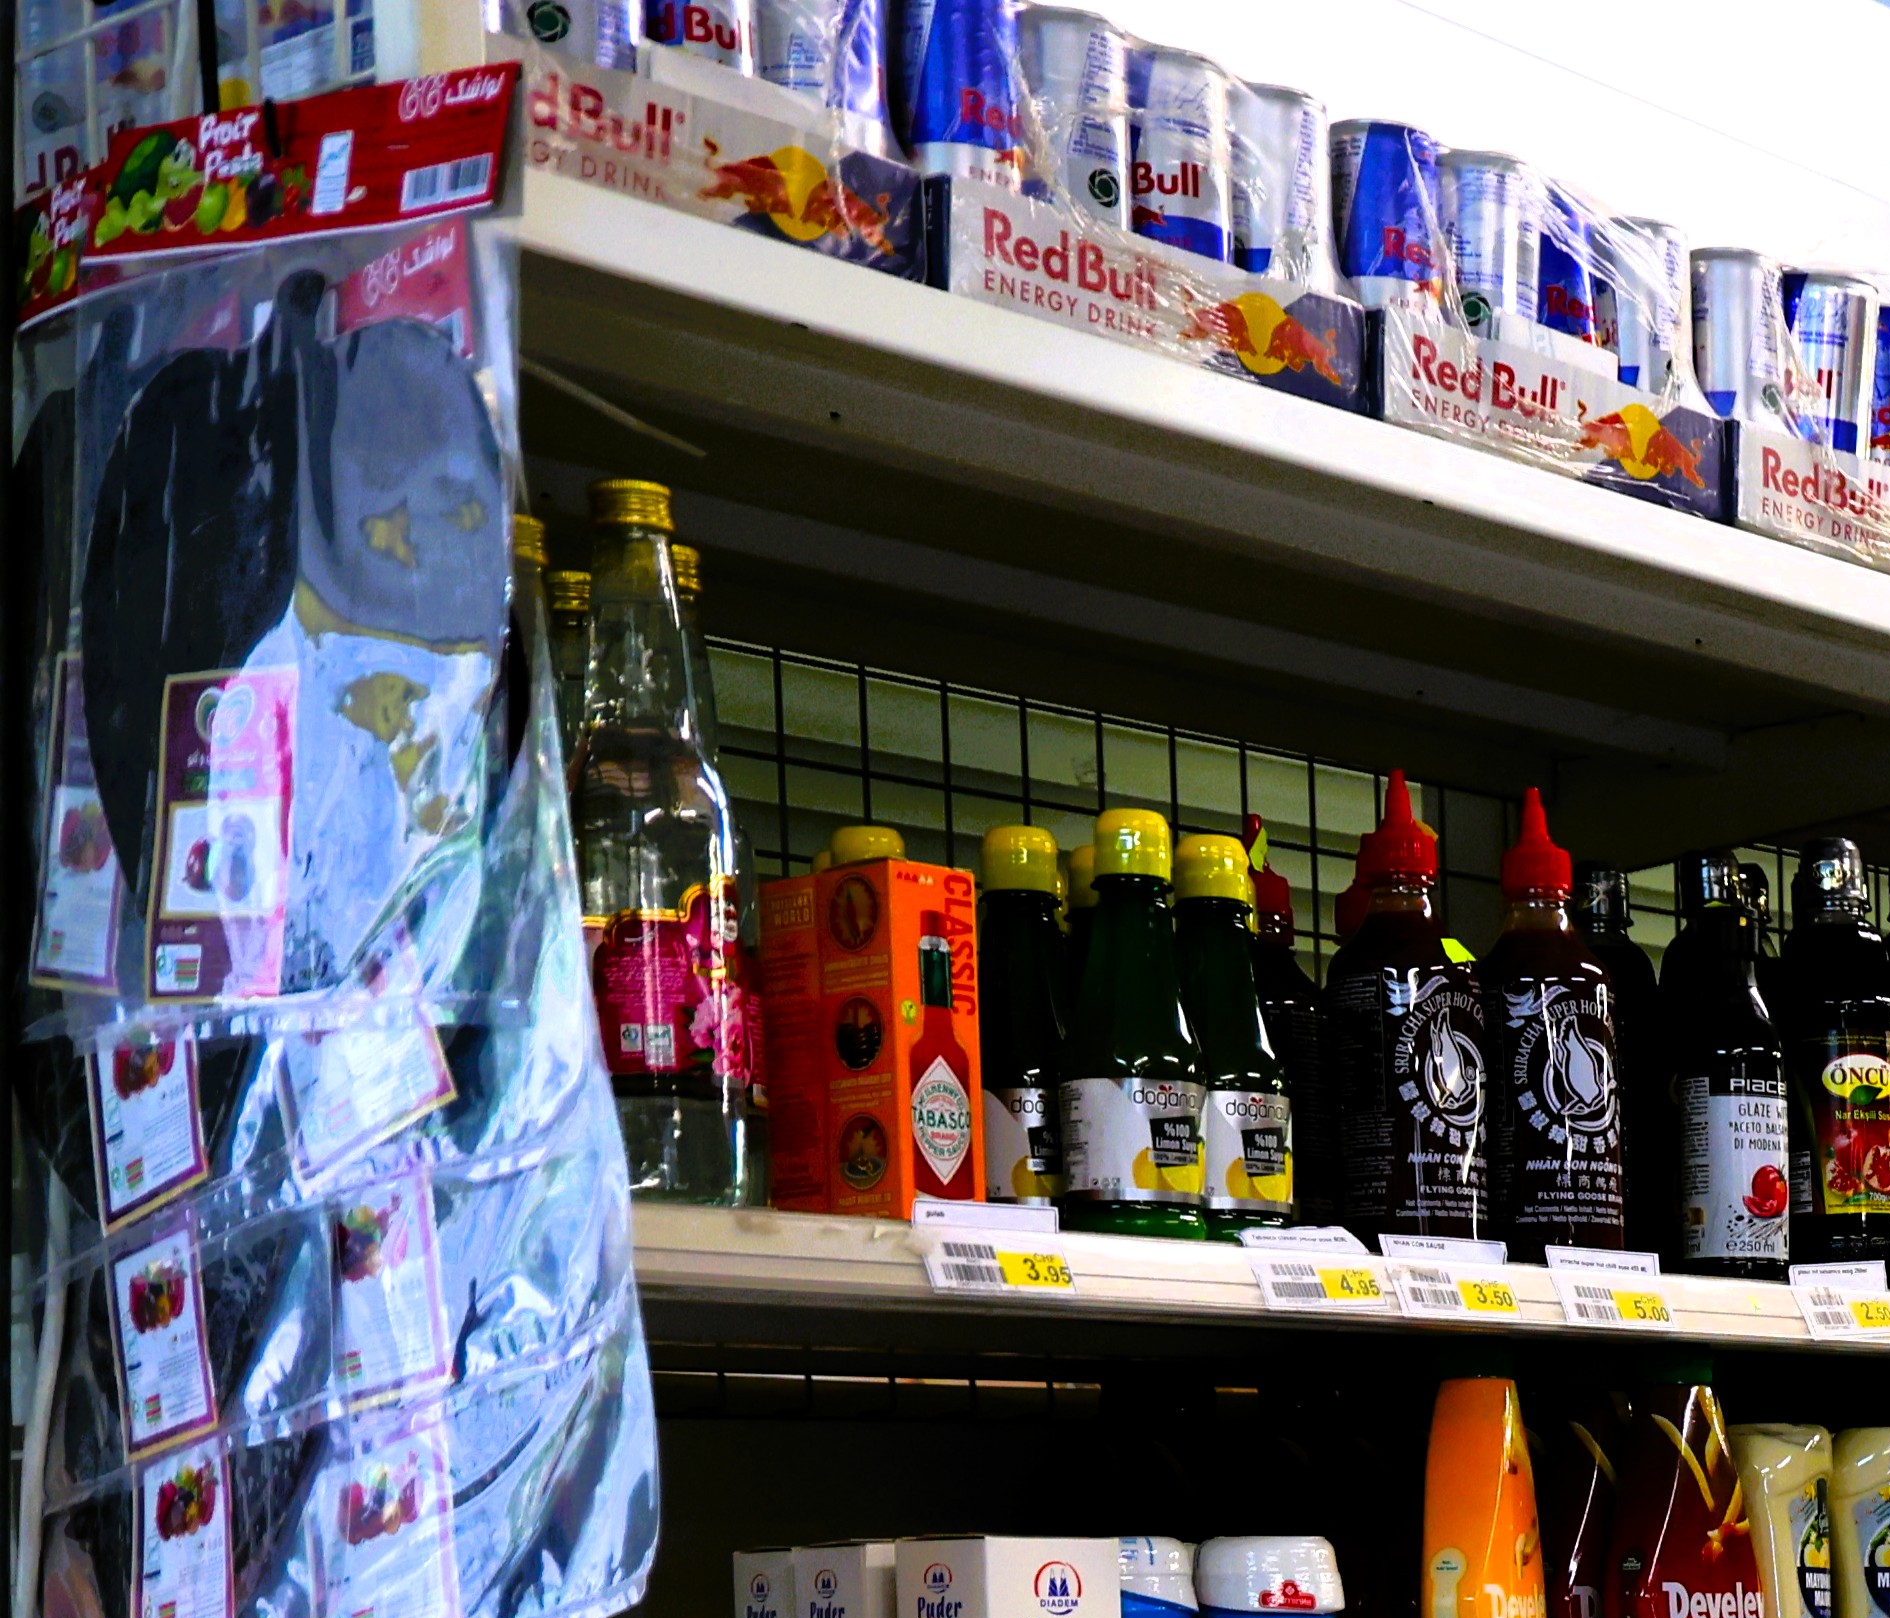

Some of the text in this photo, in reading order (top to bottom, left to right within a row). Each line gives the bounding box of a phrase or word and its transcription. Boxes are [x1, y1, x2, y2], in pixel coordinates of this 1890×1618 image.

[1130, 161, 1200, 198] Bull
[984, 207, 1068, 283] Red
[984, 270, 1078, 316] ENERGY
[1412, 334, 1483, 404] Red
[1411, 390, 1489, 433] ENERGY
[1762, 446, 1820, 504] Red
[1762, 497, 1824, 530] ENERGY
[943, 874, 977, 1017] CLASSIC
[1394, 991, 1473, 1075] SRIRACHA SUPER HOT
[1514, 1022, 1545, 1086] SRIRACHA
[1830, 1062, 1890, 1087] ÖNCÜ
[1739, 1103, 1772, 1118] GLAZE
[1835, 1110, 1851, 1121] Nar
[1420, 1185, 1454, 1196] FLYING
[1538, 1191, 1607, 1203] FLYING GOOSE
[1023, 1258, 1072, 1284] 3.95
[1340, 1273, 1380, 1297] 4.95
[1473, 1283, 1513, 1307] 3.50
[1634, 1300, 1670, 1322] 5.00
[1040, 1598, 1079, 1608] DIADEM
